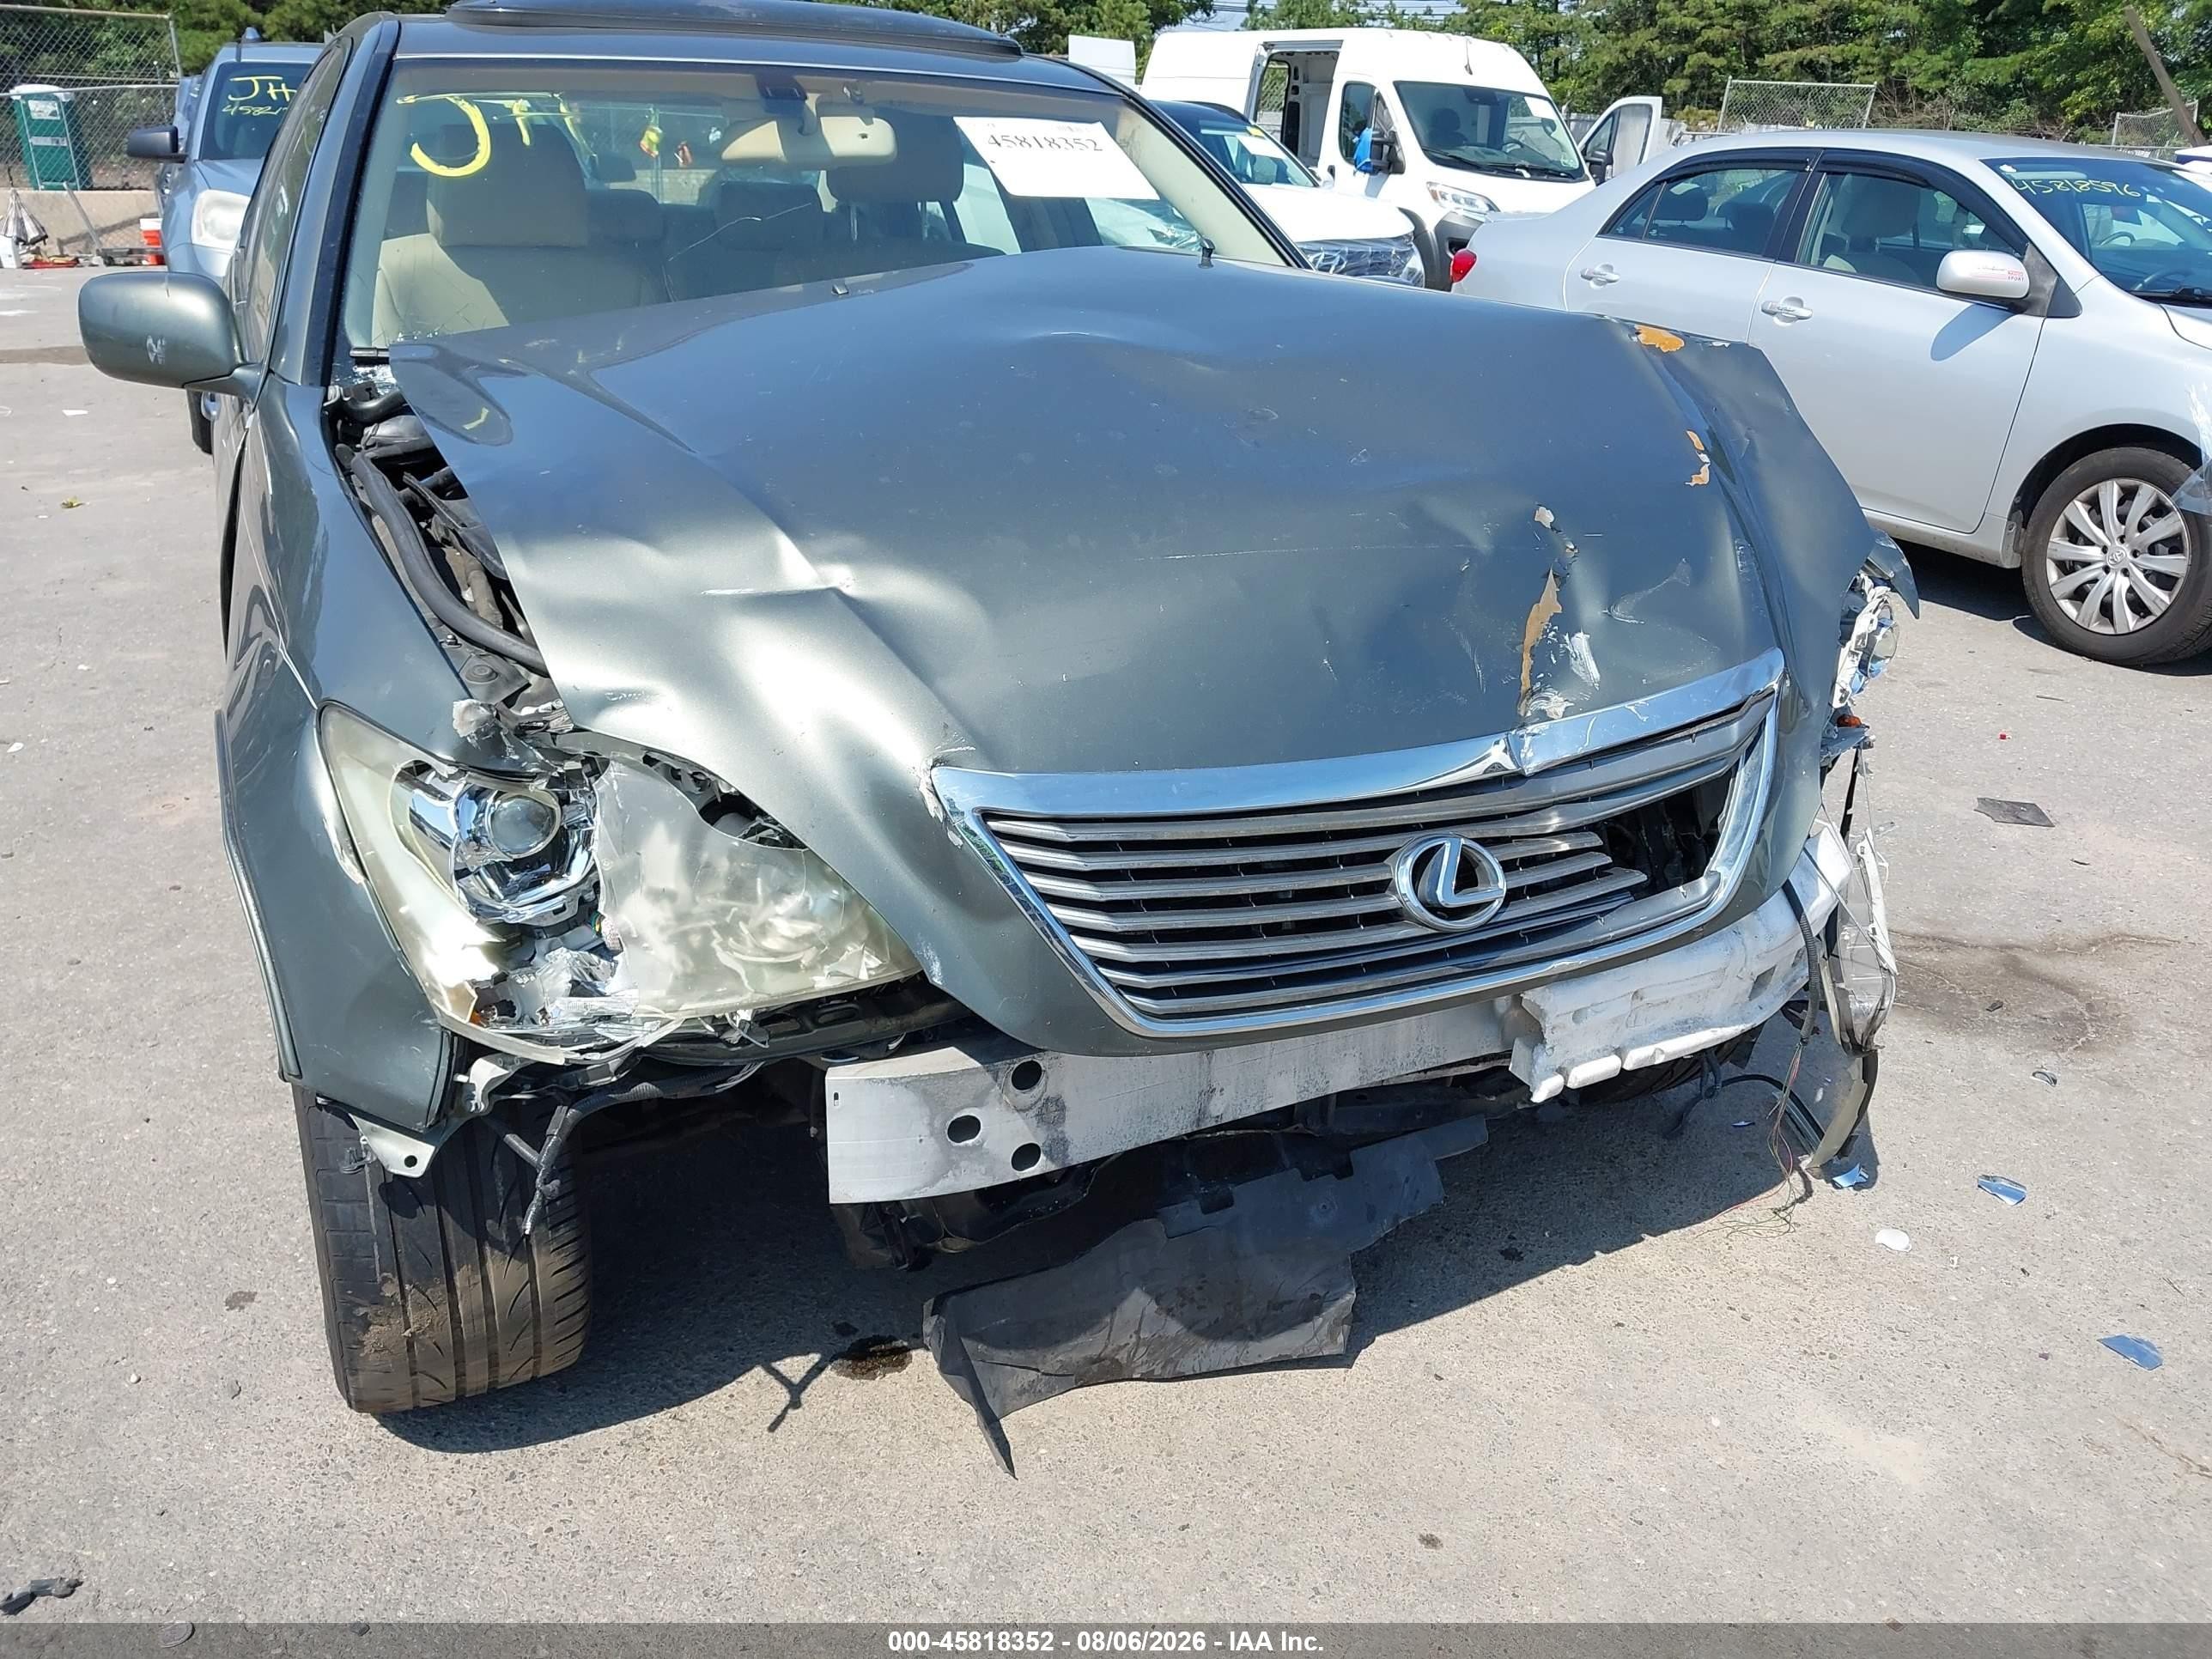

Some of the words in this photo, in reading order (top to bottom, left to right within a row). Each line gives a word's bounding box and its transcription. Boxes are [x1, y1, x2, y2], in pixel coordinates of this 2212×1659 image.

[227, 76, 297, 102] JH
[988, 134, 1103, 152] 45818352
[2010, 179, 2142, 198] 45818596
